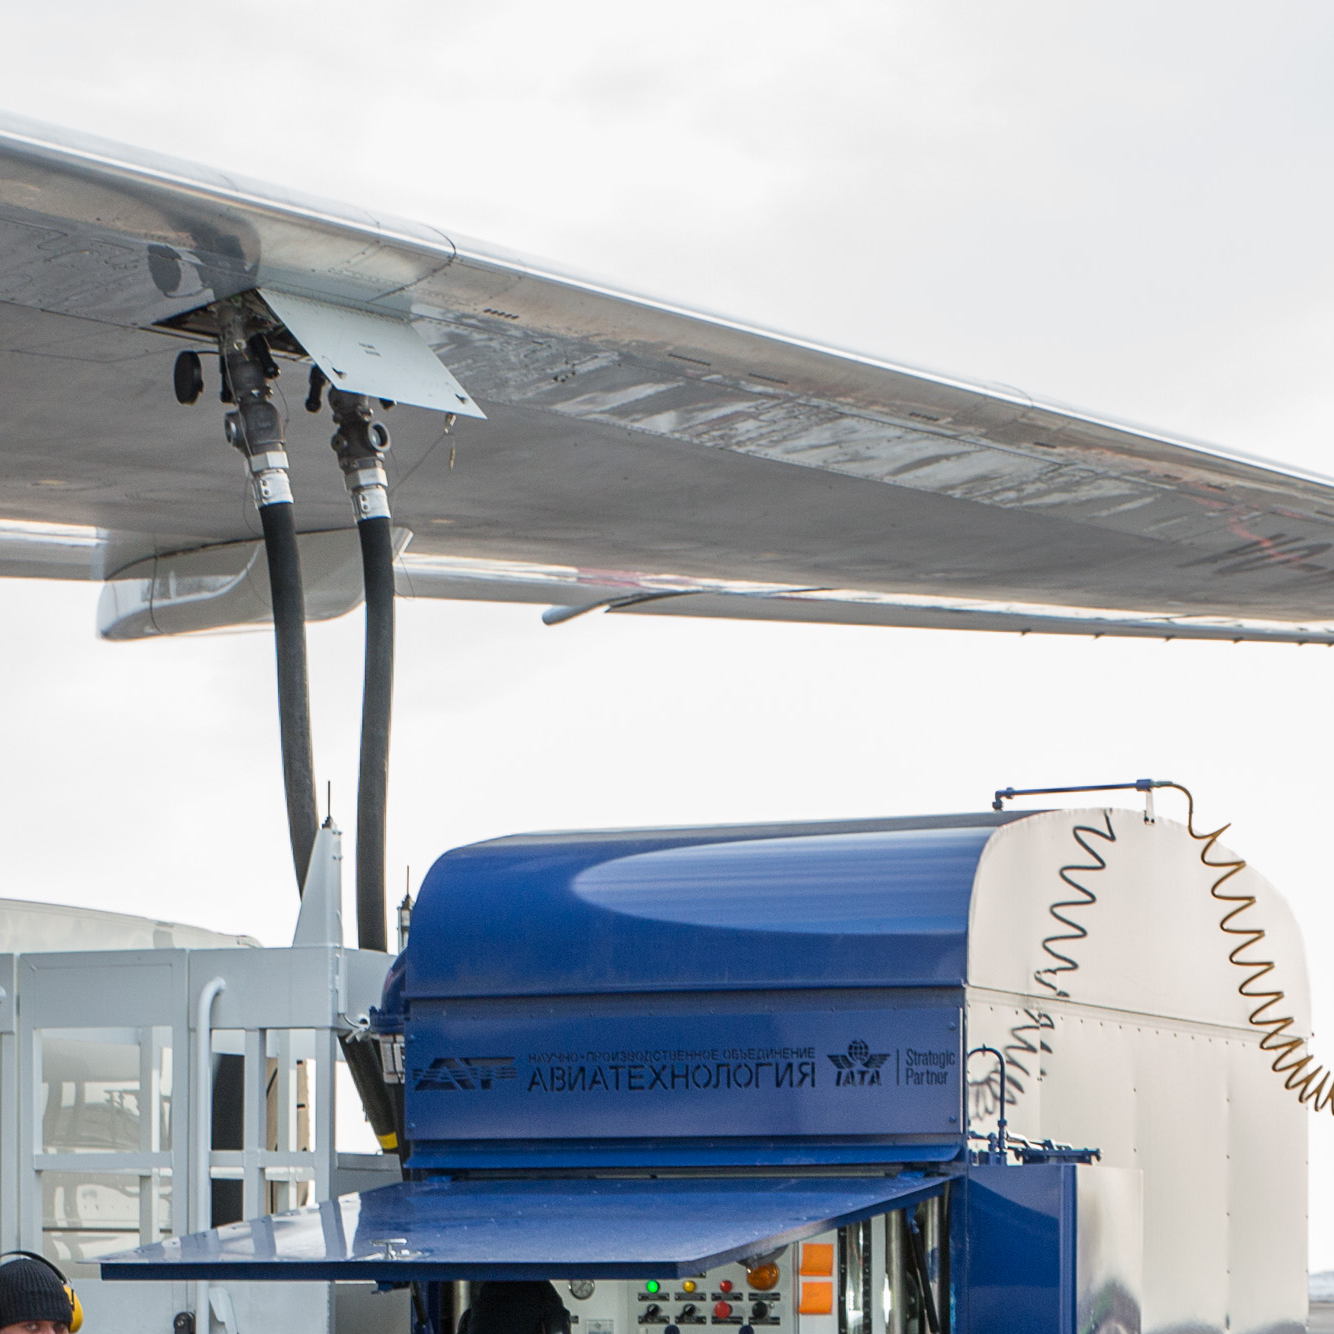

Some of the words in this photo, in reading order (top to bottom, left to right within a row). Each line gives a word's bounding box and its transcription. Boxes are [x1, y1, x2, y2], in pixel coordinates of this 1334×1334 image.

[722, 1046, 816, 1062] ОБЪЕДИНЕНИЕ
[905, 1048, 956, 1069] Strategic
[527, 1061, 816, 1093] АВИАТЕХНОЛОГИЯ
[835, 1069, 883, 1088] IATA
[905, 1068, 949, 1087] Partner
